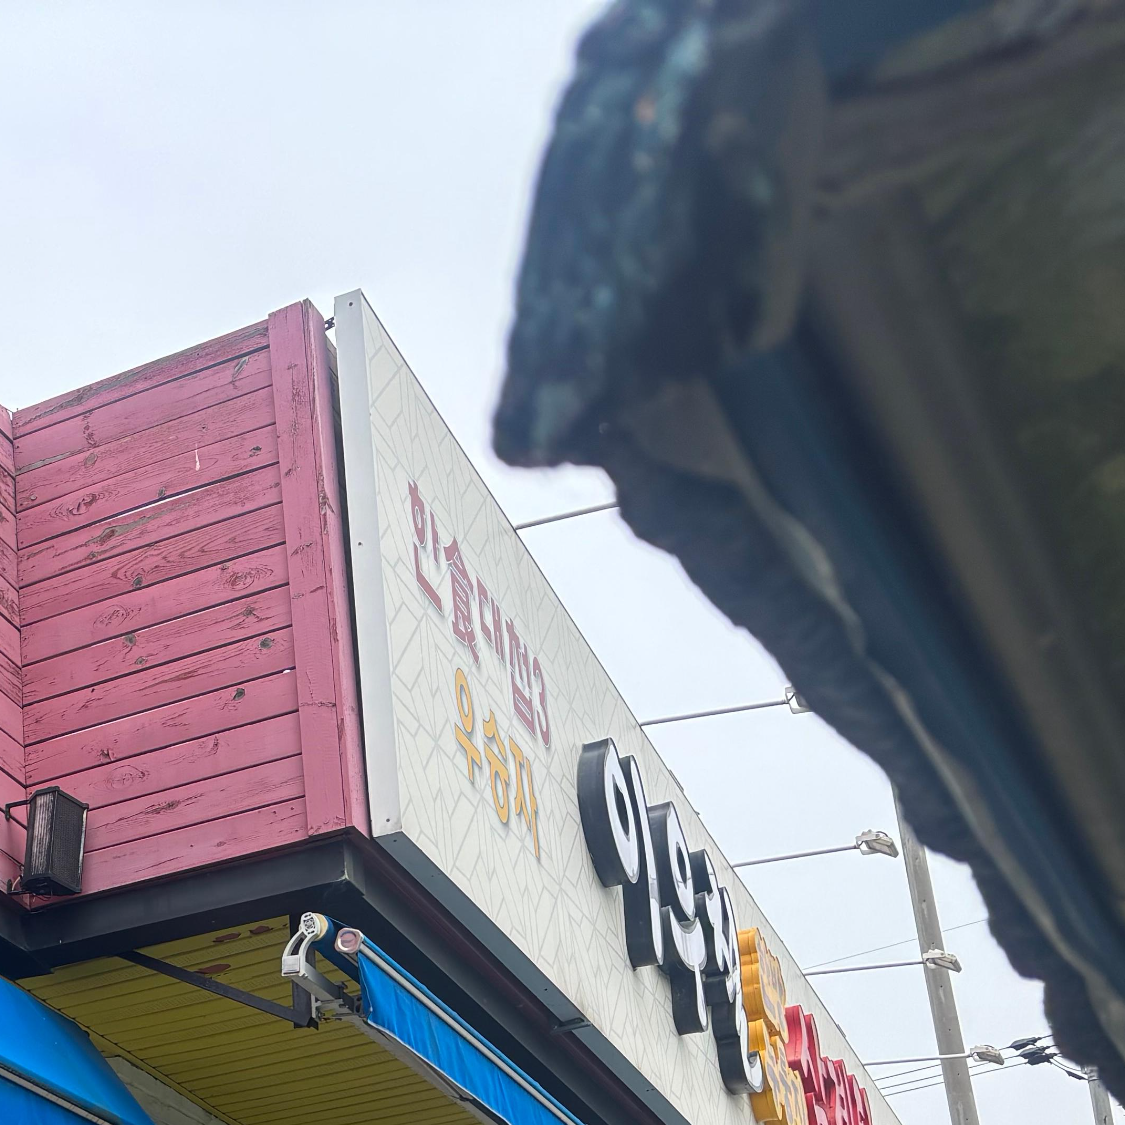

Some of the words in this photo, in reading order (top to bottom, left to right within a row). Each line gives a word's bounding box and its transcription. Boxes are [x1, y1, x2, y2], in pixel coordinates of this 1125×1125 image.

[408, 480, 551, 747] 한食대첩3
[454, 667, 540, 859] 우승자
[581, 737, 764, 1094] 이우철
